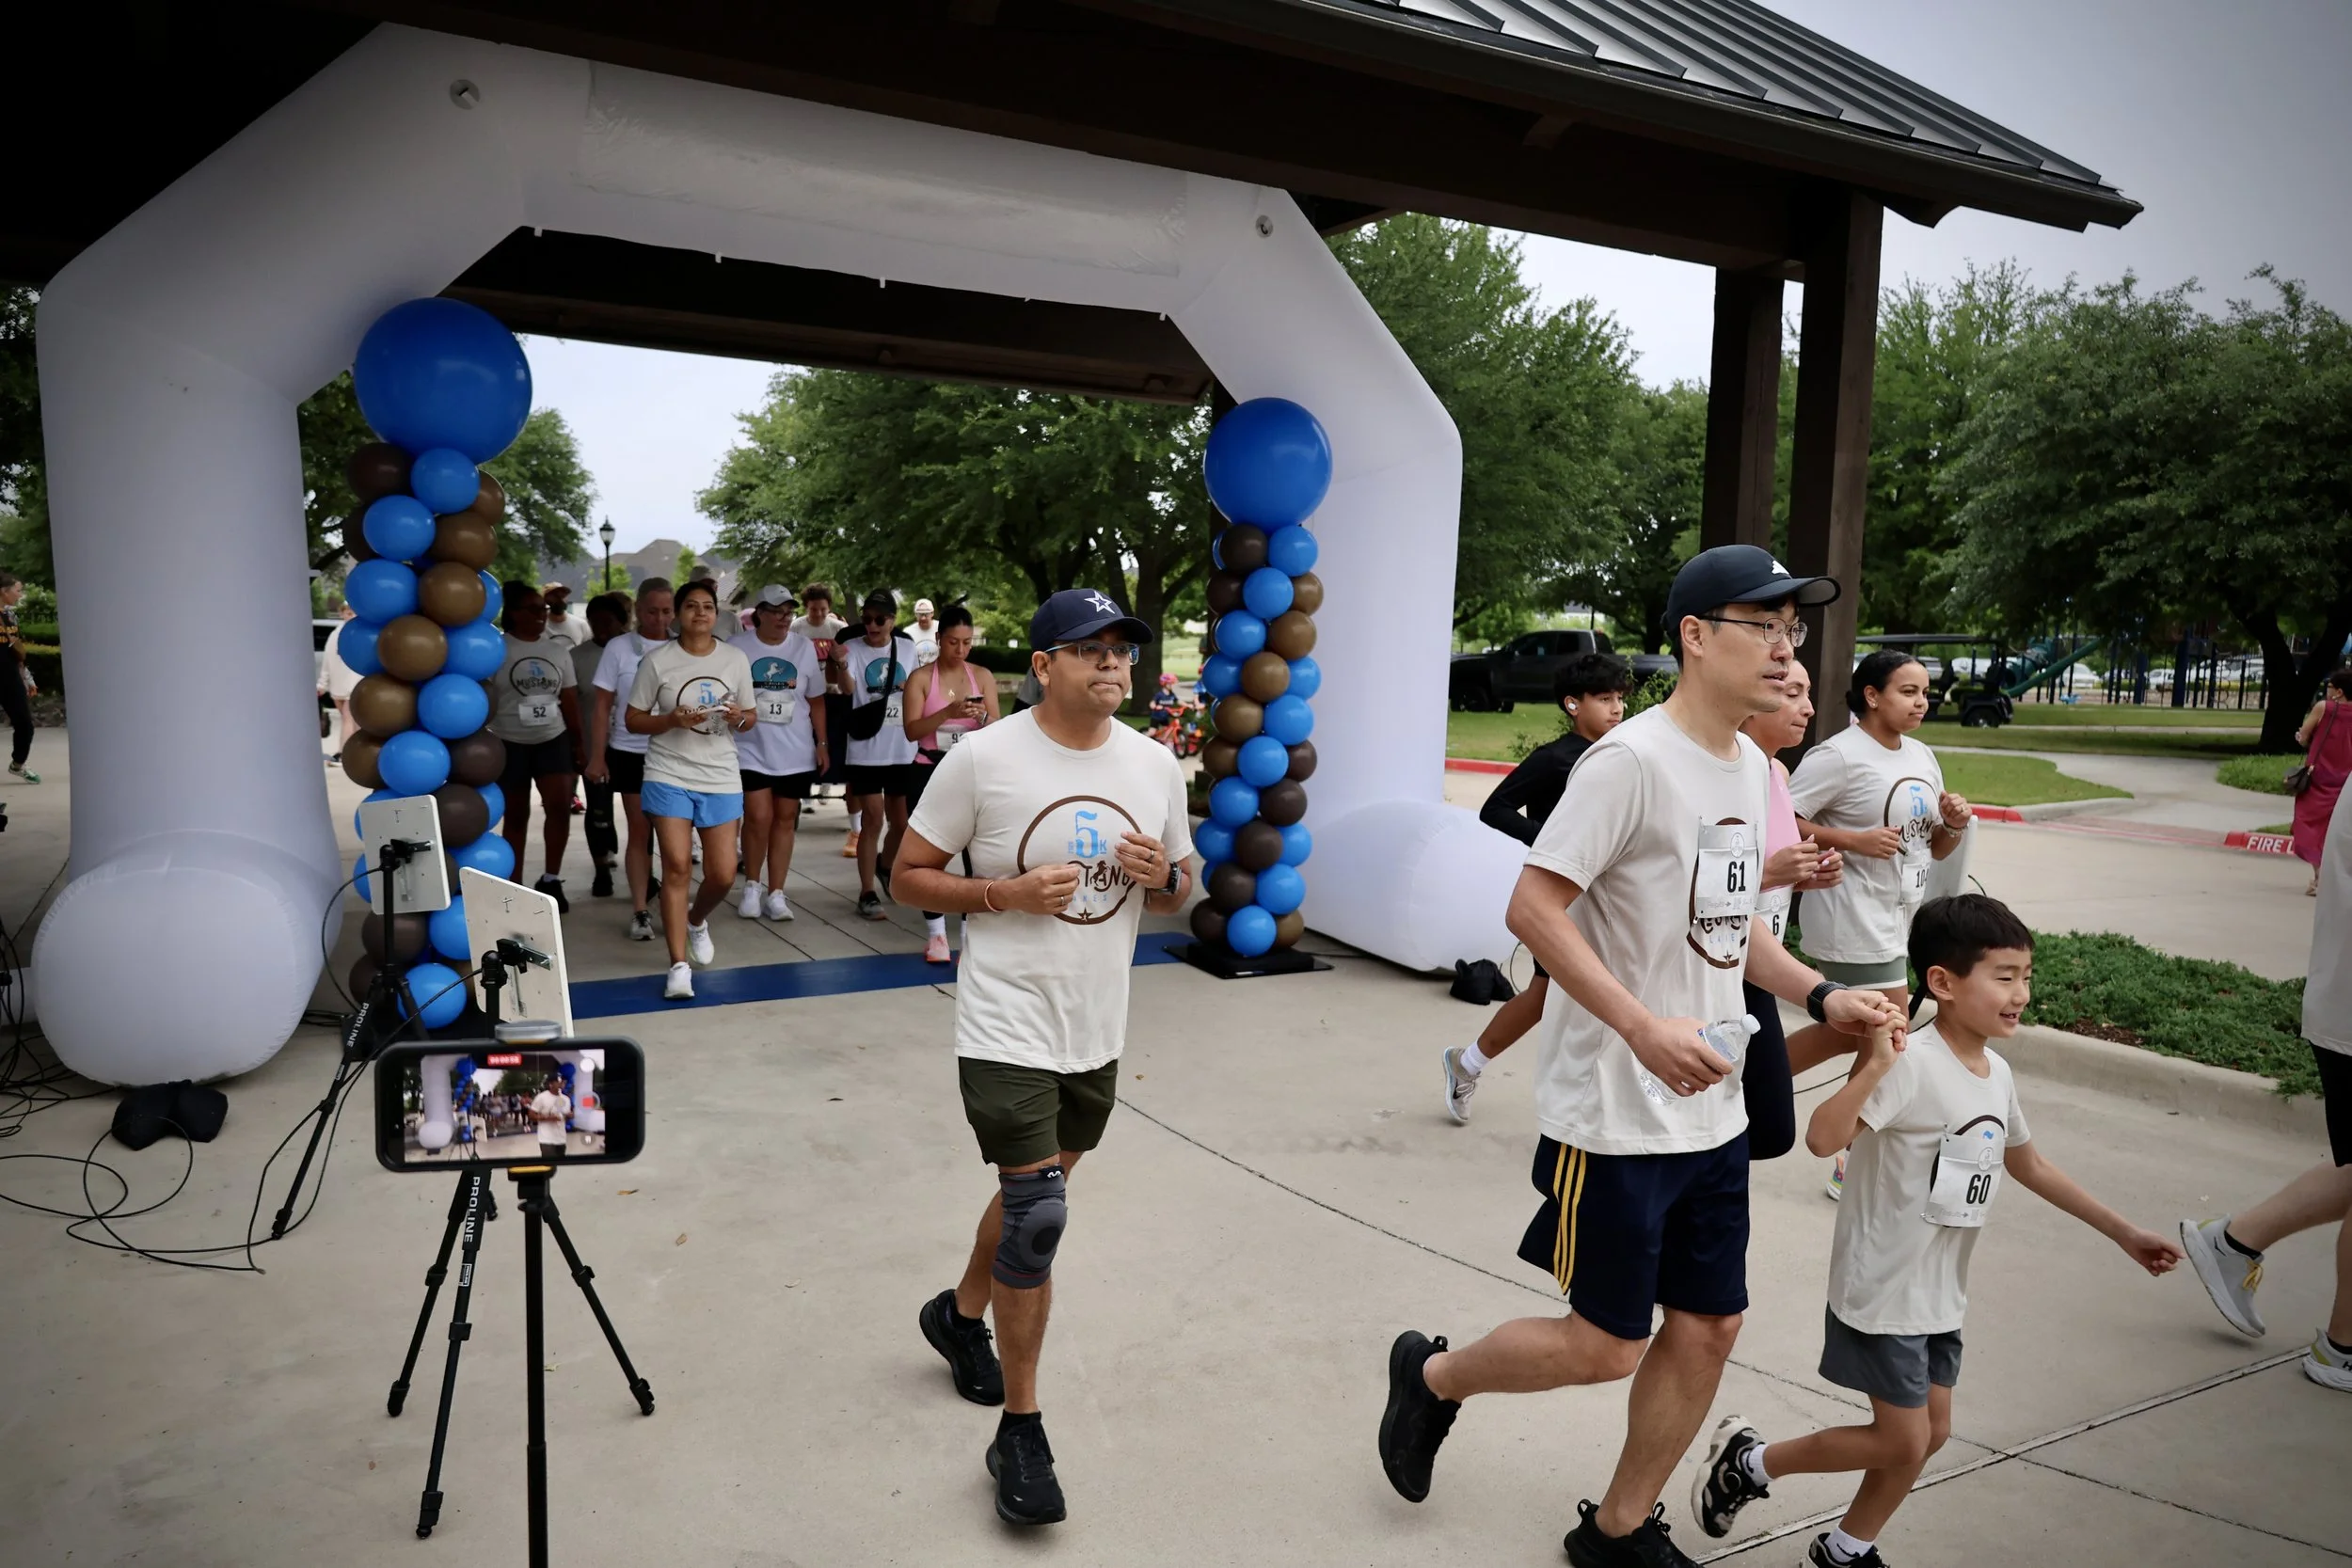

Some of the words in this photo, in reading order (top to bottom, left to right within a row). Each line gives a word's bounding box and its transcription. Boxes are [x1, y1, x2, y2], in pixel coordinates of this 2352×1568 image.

[533, 706, 547, 718] 52
[770, 704, 783, 716] 13
[886, 707, 898, 718] 22
[2247, 836, 2284, 853] FIRE
[1727, 861, 1747, 893] 61
[1772, 913, 1780, 936] 6
[346, 1002, 370, 1048] PROLINE
[1966, 1174, 1992, 1205] 60
[464, 1176, 481, 1243] PROLINE
